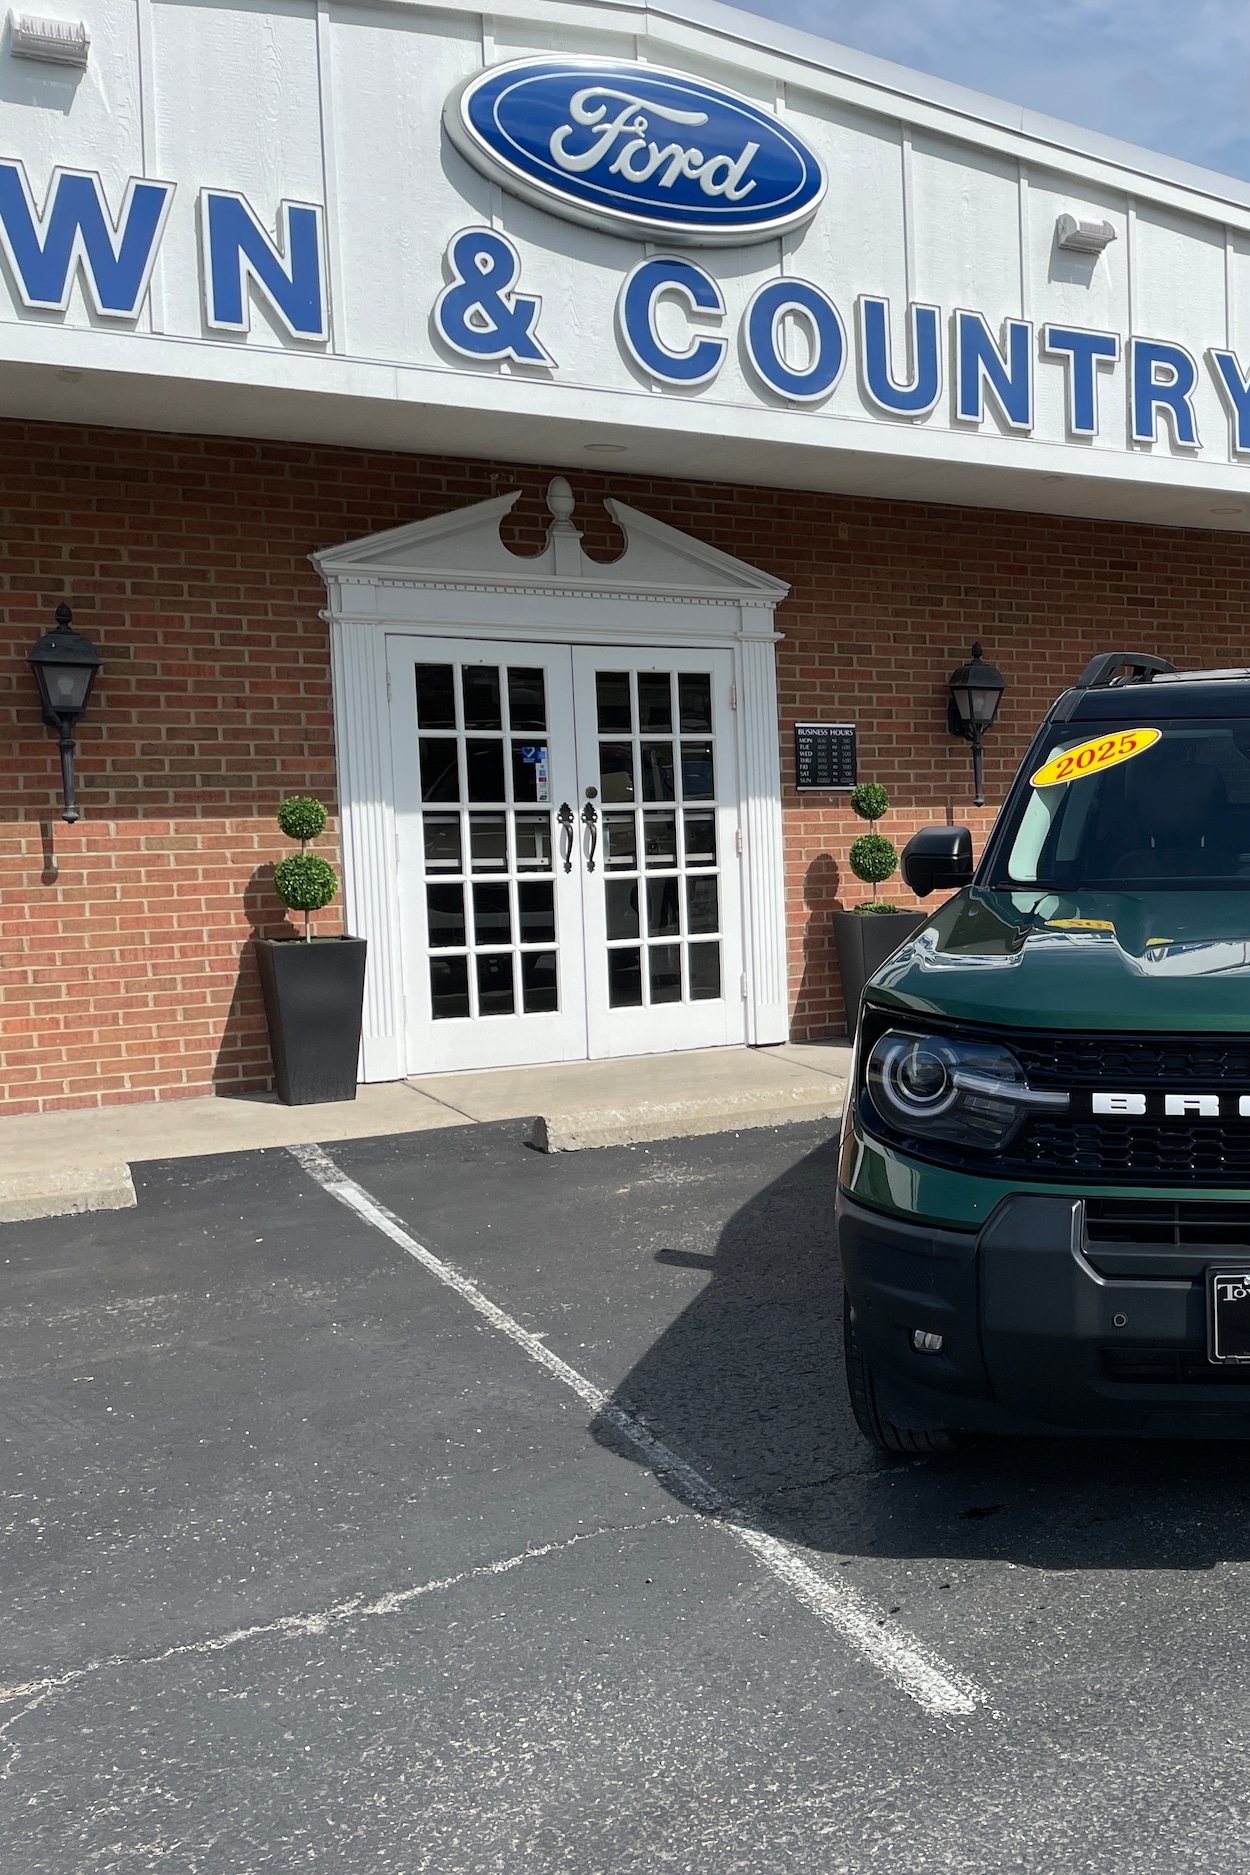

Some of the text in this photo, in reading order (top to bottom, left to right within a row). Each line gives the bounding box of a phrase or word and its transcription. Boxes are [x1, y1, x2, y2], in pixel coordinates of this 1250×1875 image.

[549, 86, 760, 201] Ford
[433, 225, 557, 369] &
[1056, 733, 1137, 780] 2025
